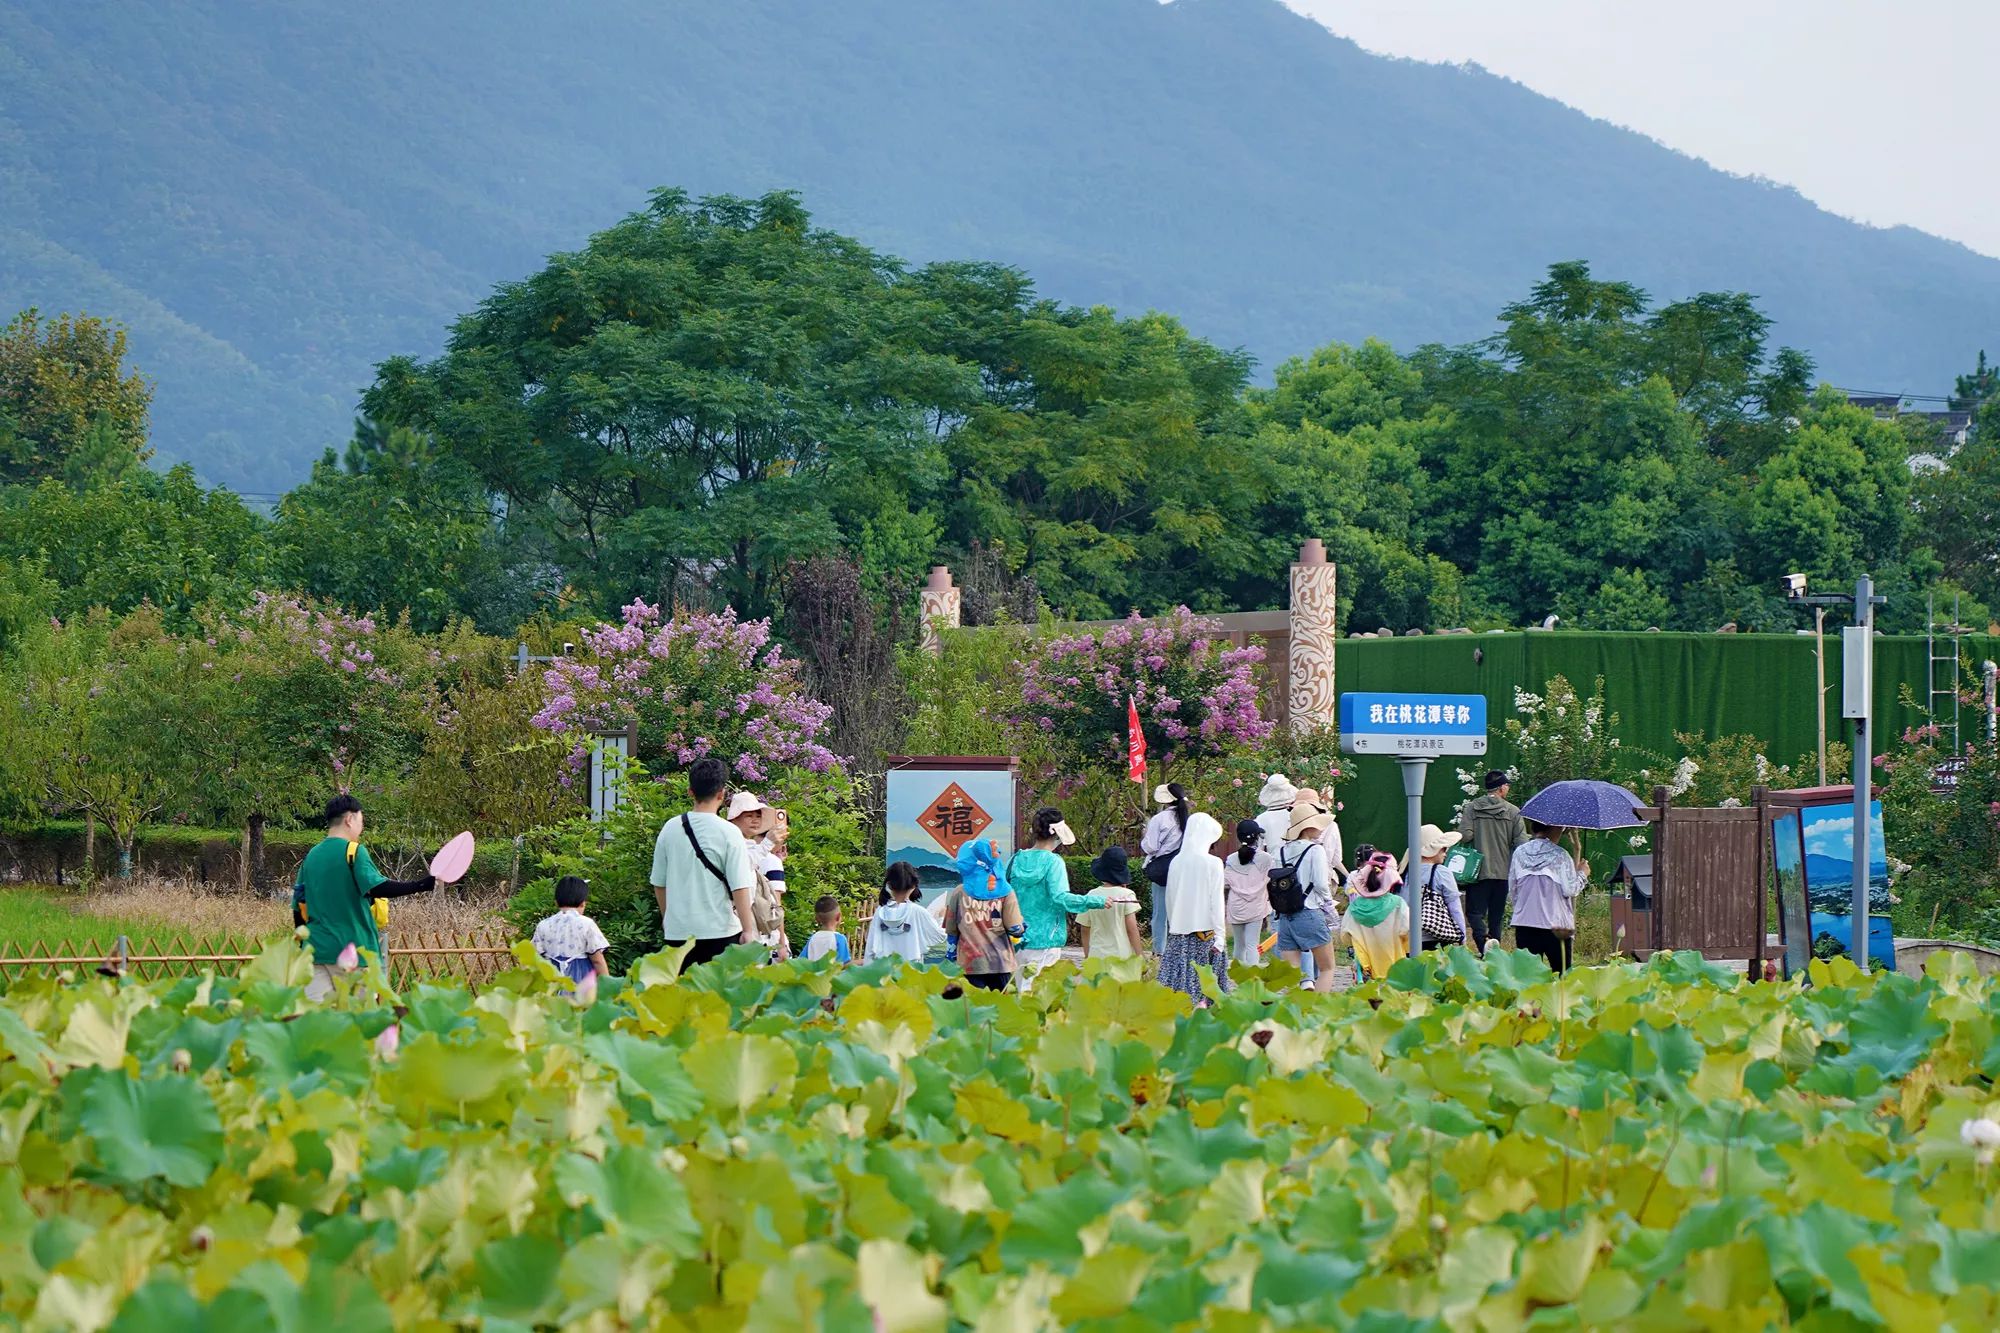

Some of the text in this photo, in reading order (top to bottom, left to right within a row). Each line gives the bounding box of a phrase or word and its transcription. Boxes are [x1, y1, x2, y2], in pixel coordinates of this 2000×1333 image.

[1369, 703, 1471, 725] 我在桃花潭等你
[1473, 740, 1480, 750] 西
[935, 804, 974, 839] 福
